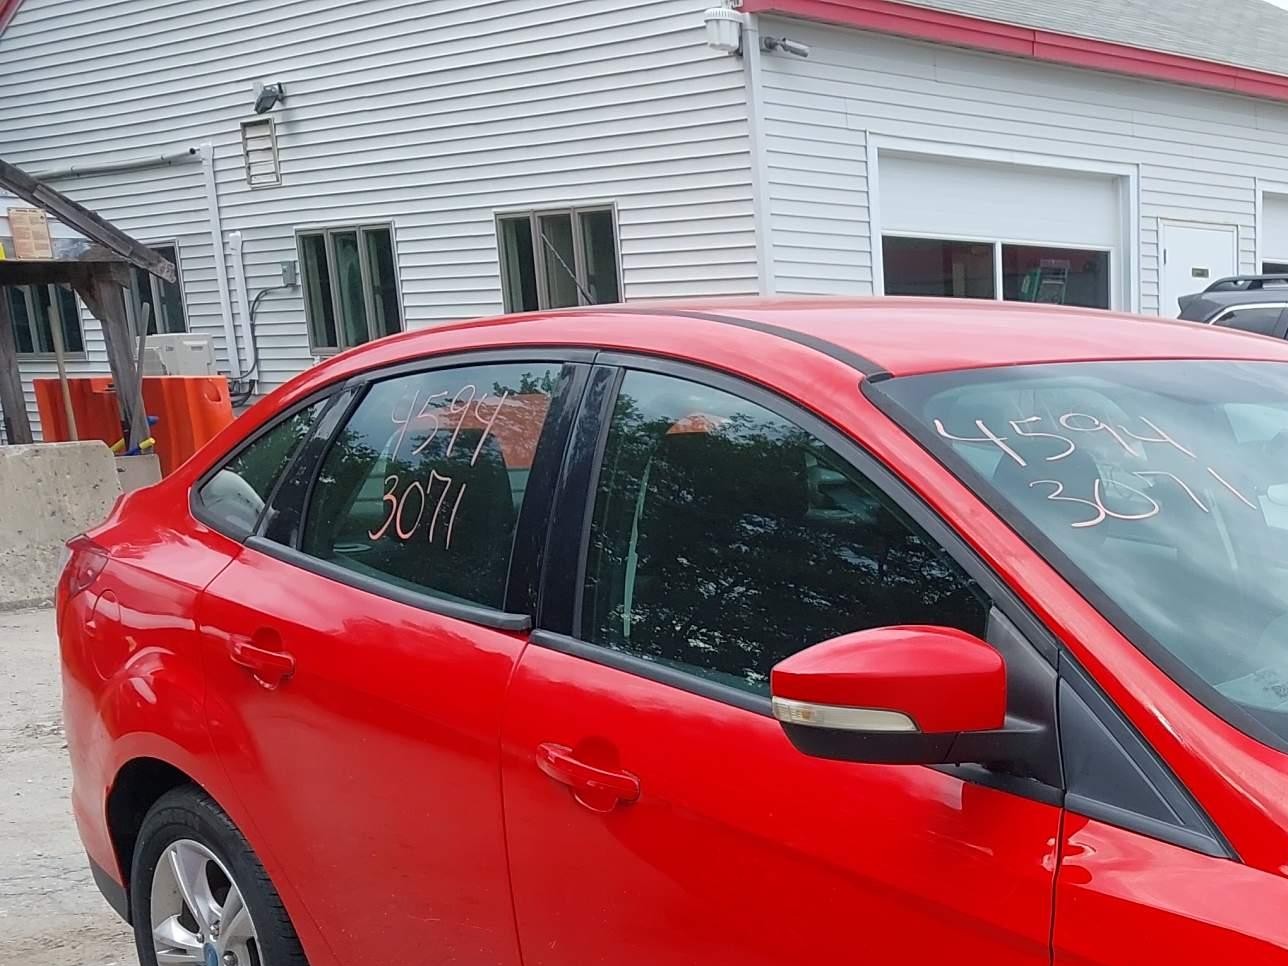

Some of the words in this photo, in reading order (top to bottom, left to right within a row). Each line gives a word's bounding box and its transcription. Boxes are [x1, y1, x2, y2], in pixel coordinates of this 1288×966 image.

[391, 384, 509, 467] 4594
[934, 412, 1197, 467] 4594
[368, 469, 466, 550] 3071
[1029, 467, 1257, 528] 3071
